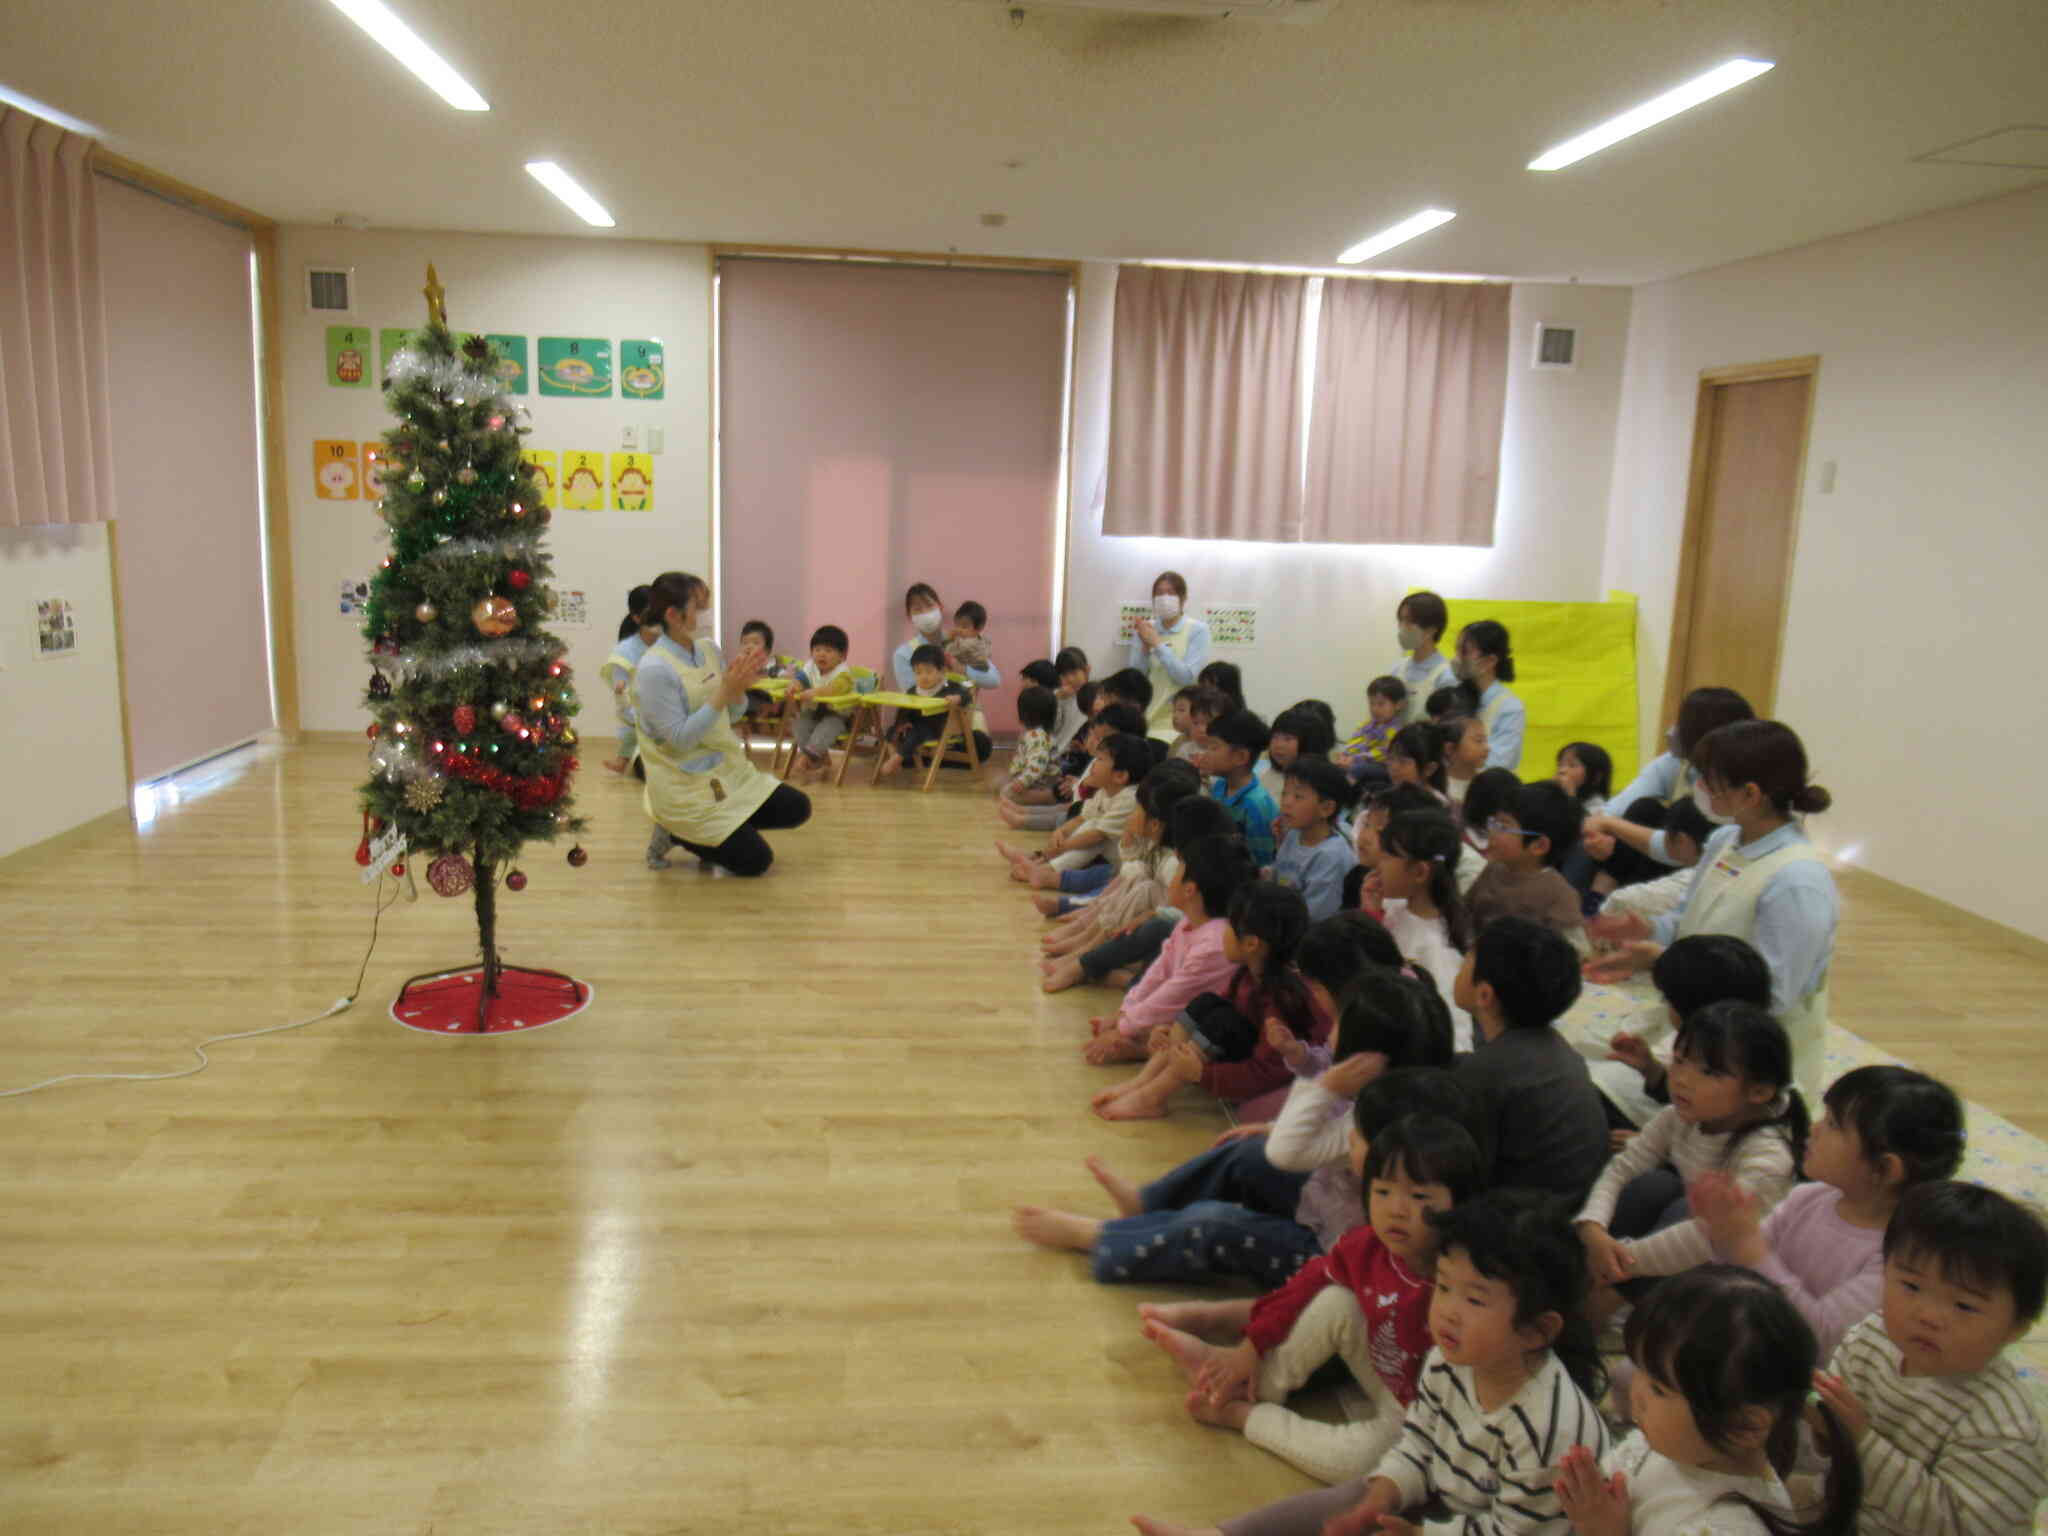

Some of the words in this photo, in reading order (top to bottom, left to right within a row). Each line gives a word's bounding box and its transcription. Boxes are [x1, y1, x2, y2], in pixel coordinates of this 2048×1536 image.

[570, 341, 580, 355] 8
[329, 444, 345, 457] 10
[579, 454, 588, 466] 2
[626, 454, 636, 467] 3
